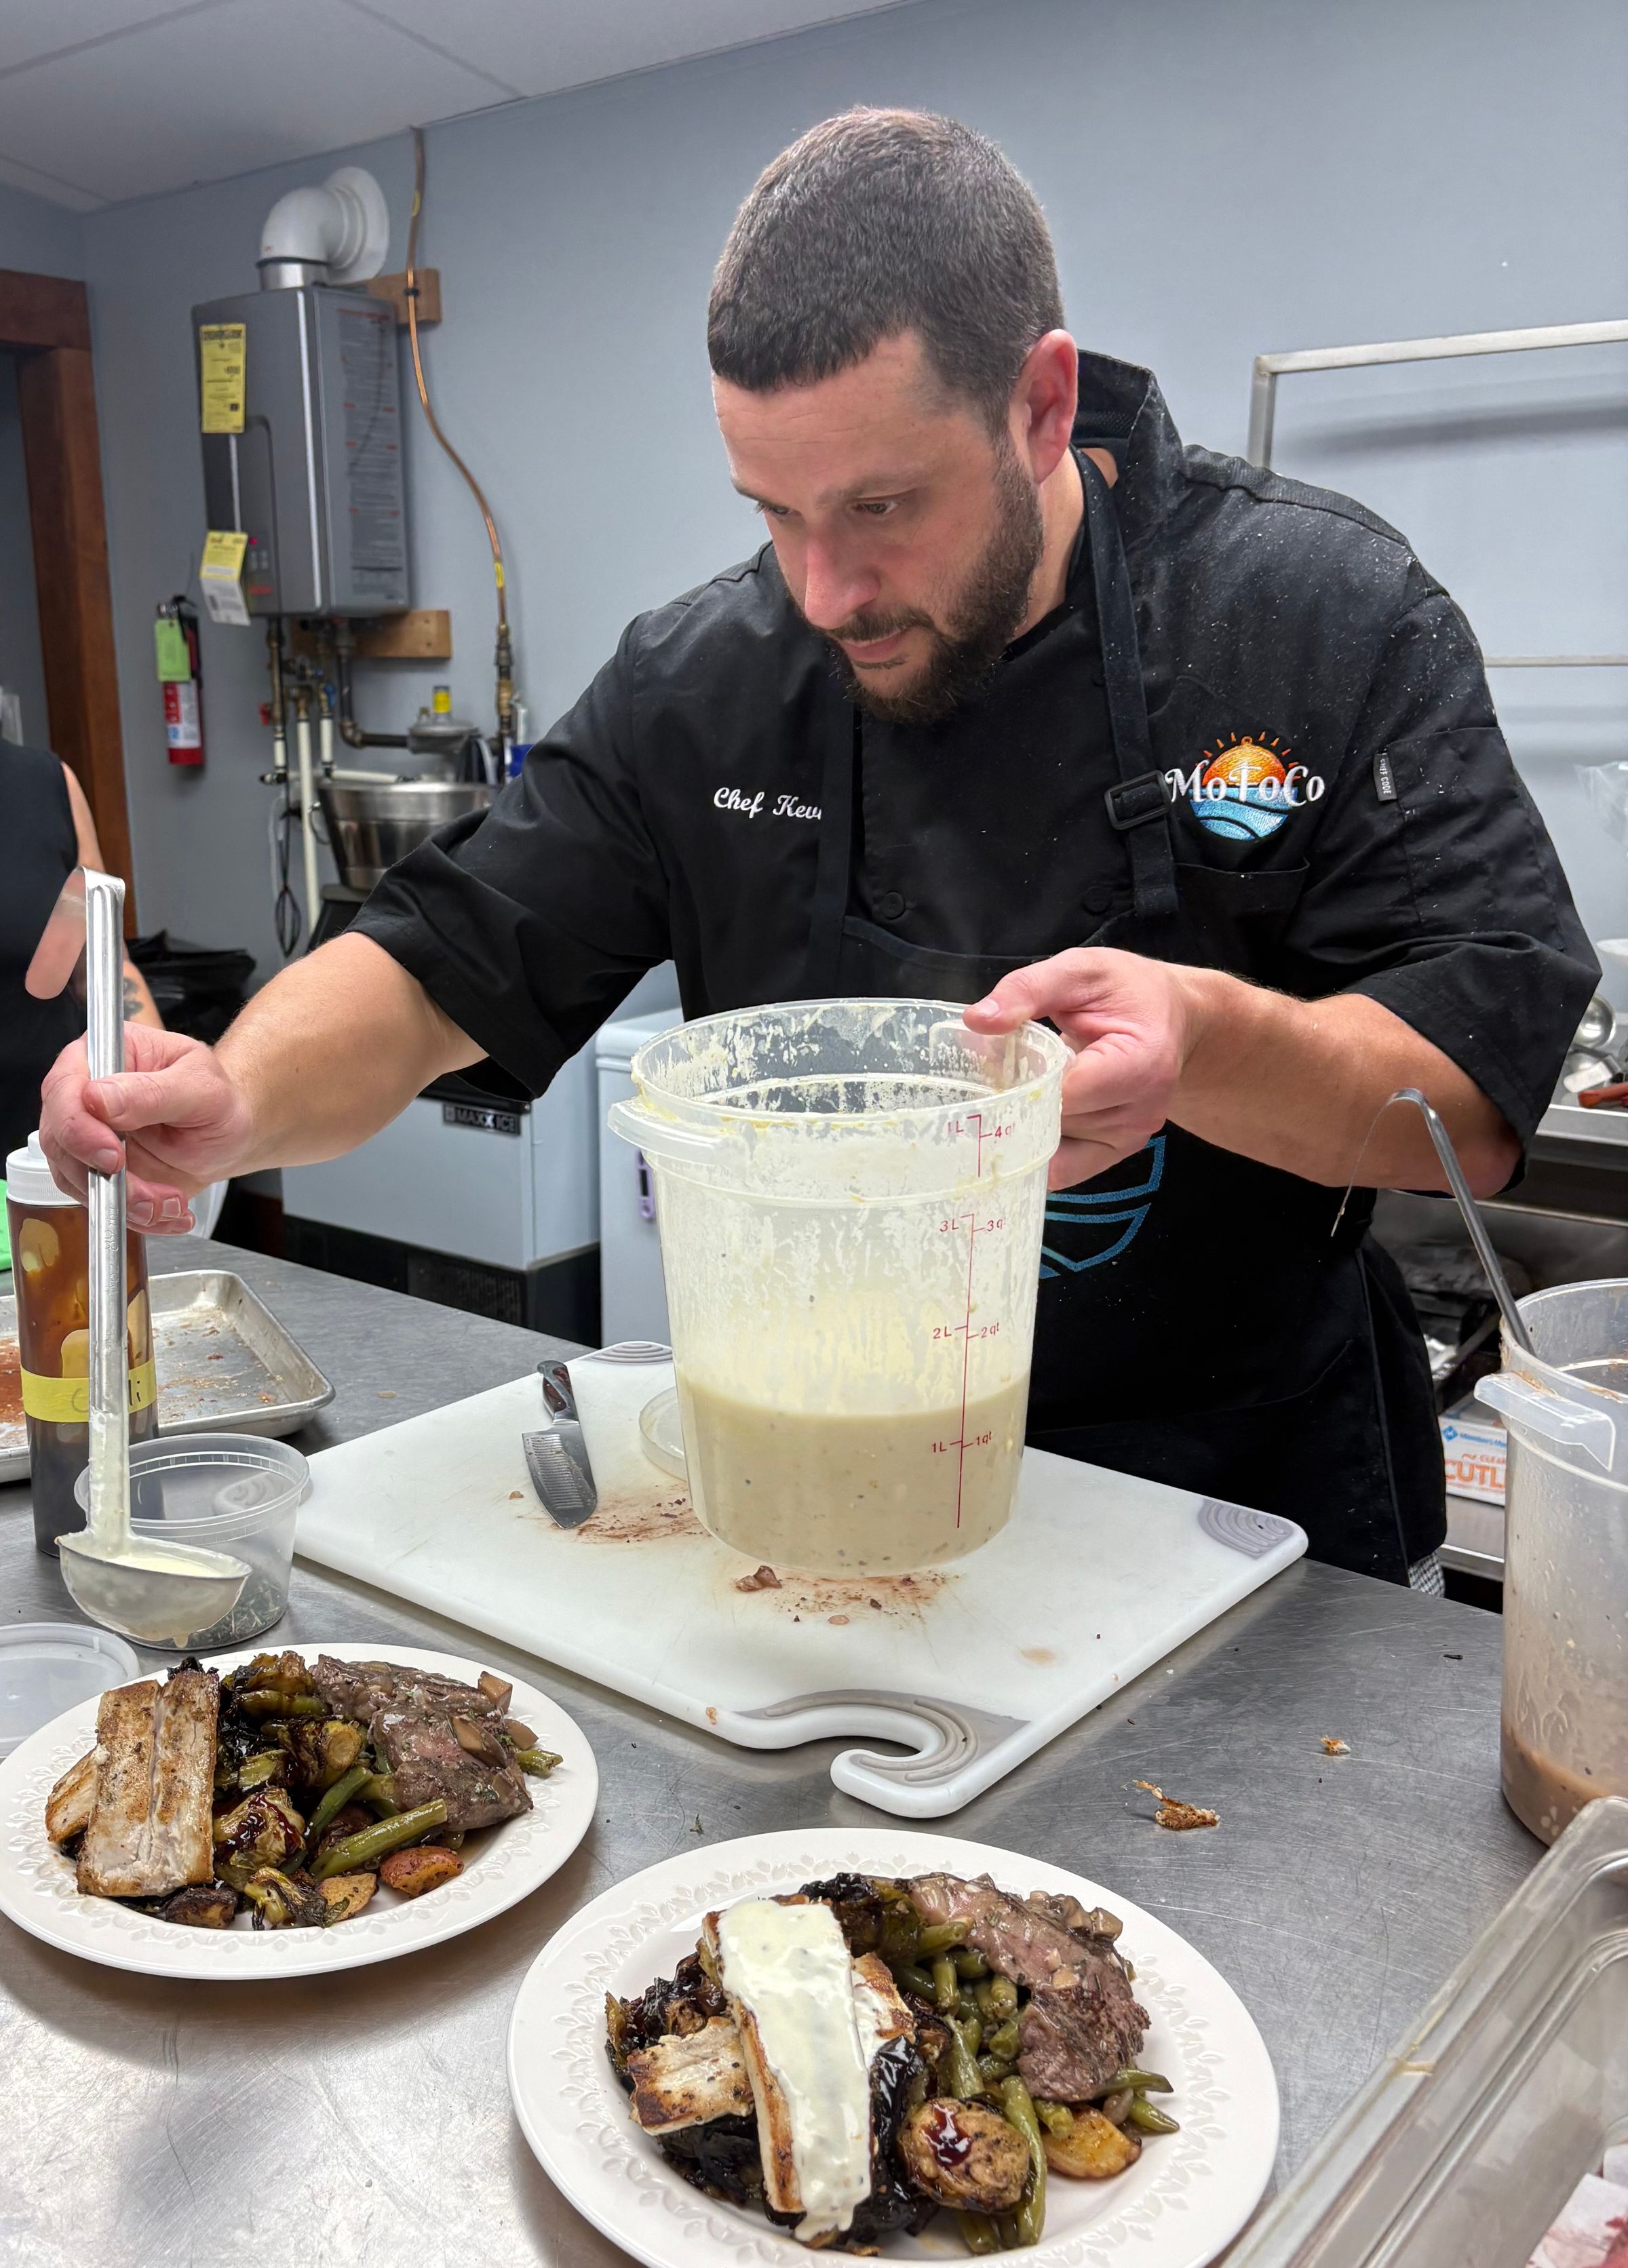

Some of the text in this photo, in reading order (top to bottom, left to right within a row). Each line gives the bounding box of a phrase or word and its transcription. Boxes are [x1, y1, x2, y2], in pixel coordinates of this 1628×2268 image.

[1165, 760, 1325, 806] MoToCo
[1379, 758, 1392, 794] CHEF CODE
[714, 787, 764, 819] Chef
